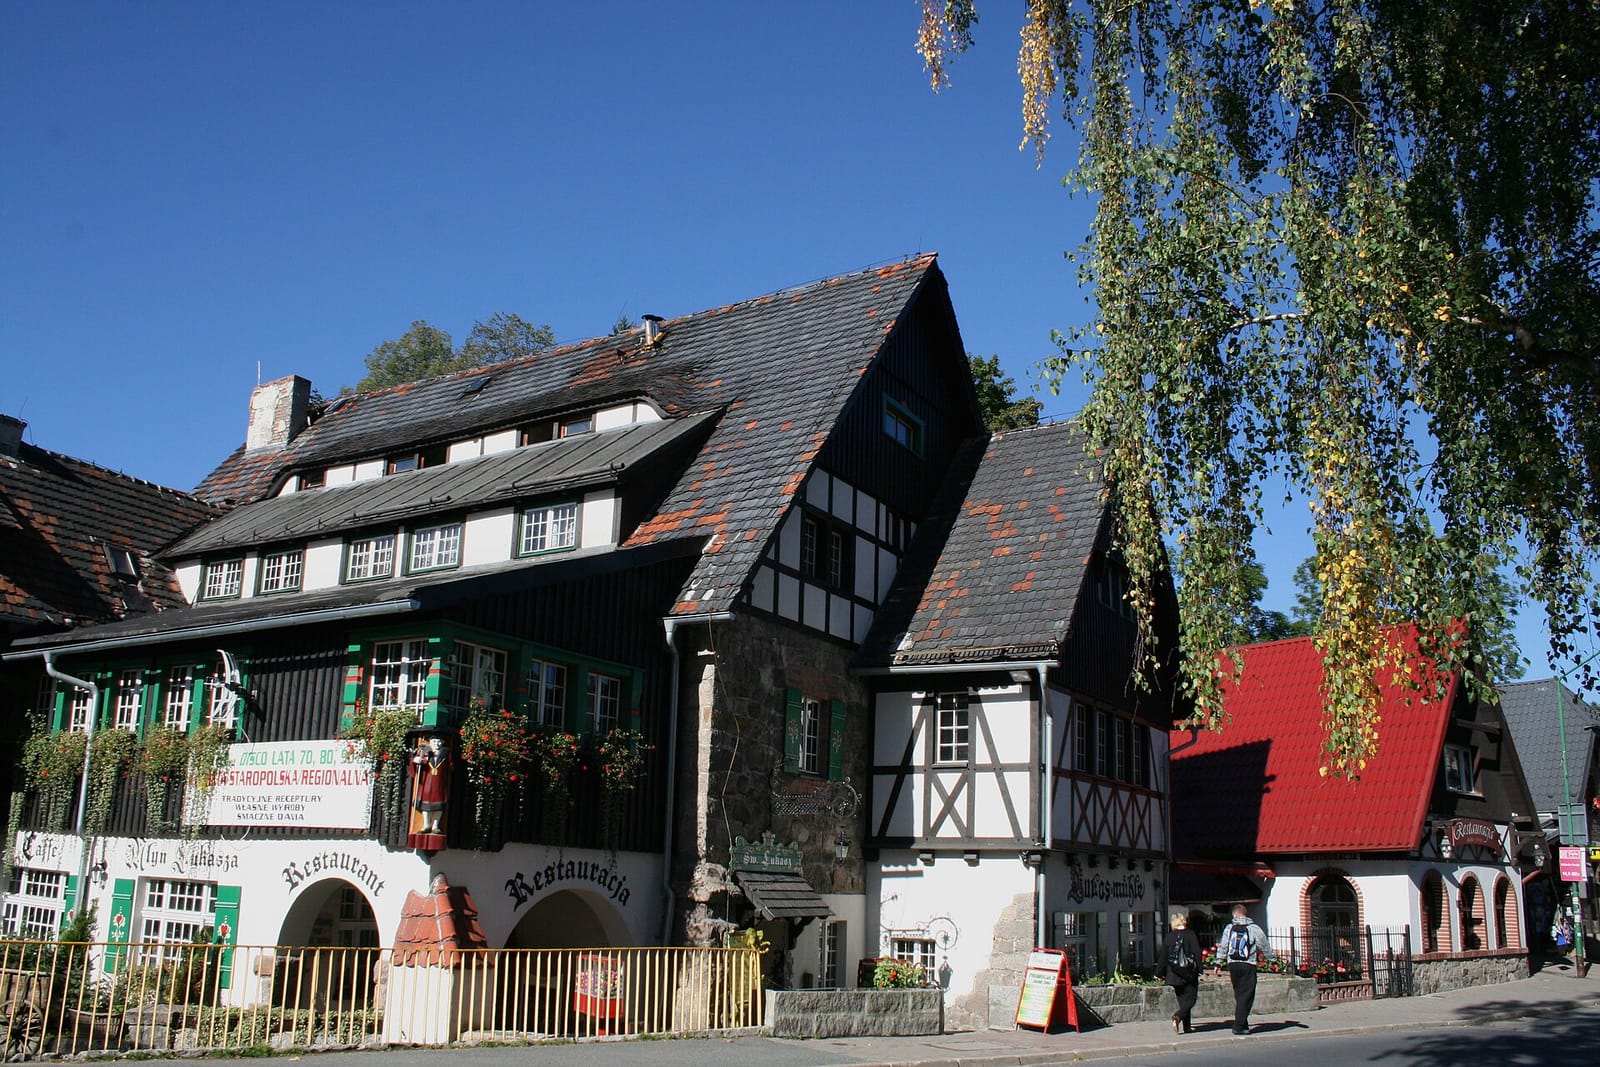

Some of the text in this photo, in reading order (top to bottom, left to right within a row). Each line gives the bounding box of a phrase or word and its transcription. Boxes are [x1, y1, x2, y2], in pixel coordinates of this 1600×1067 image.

[239, 751, 268, 766] DISCO
[272, 750, 296, 766] LATA
[222, 795, 323, 803] TRADYCYJNE RECEPTURY
[271, 803, 306, 812] WYROBY
[236, 813, 274, 821] SMACZNE
[282, 850, 385, 897] Restaurant
[504, 859, 631, 913] Restauracja
